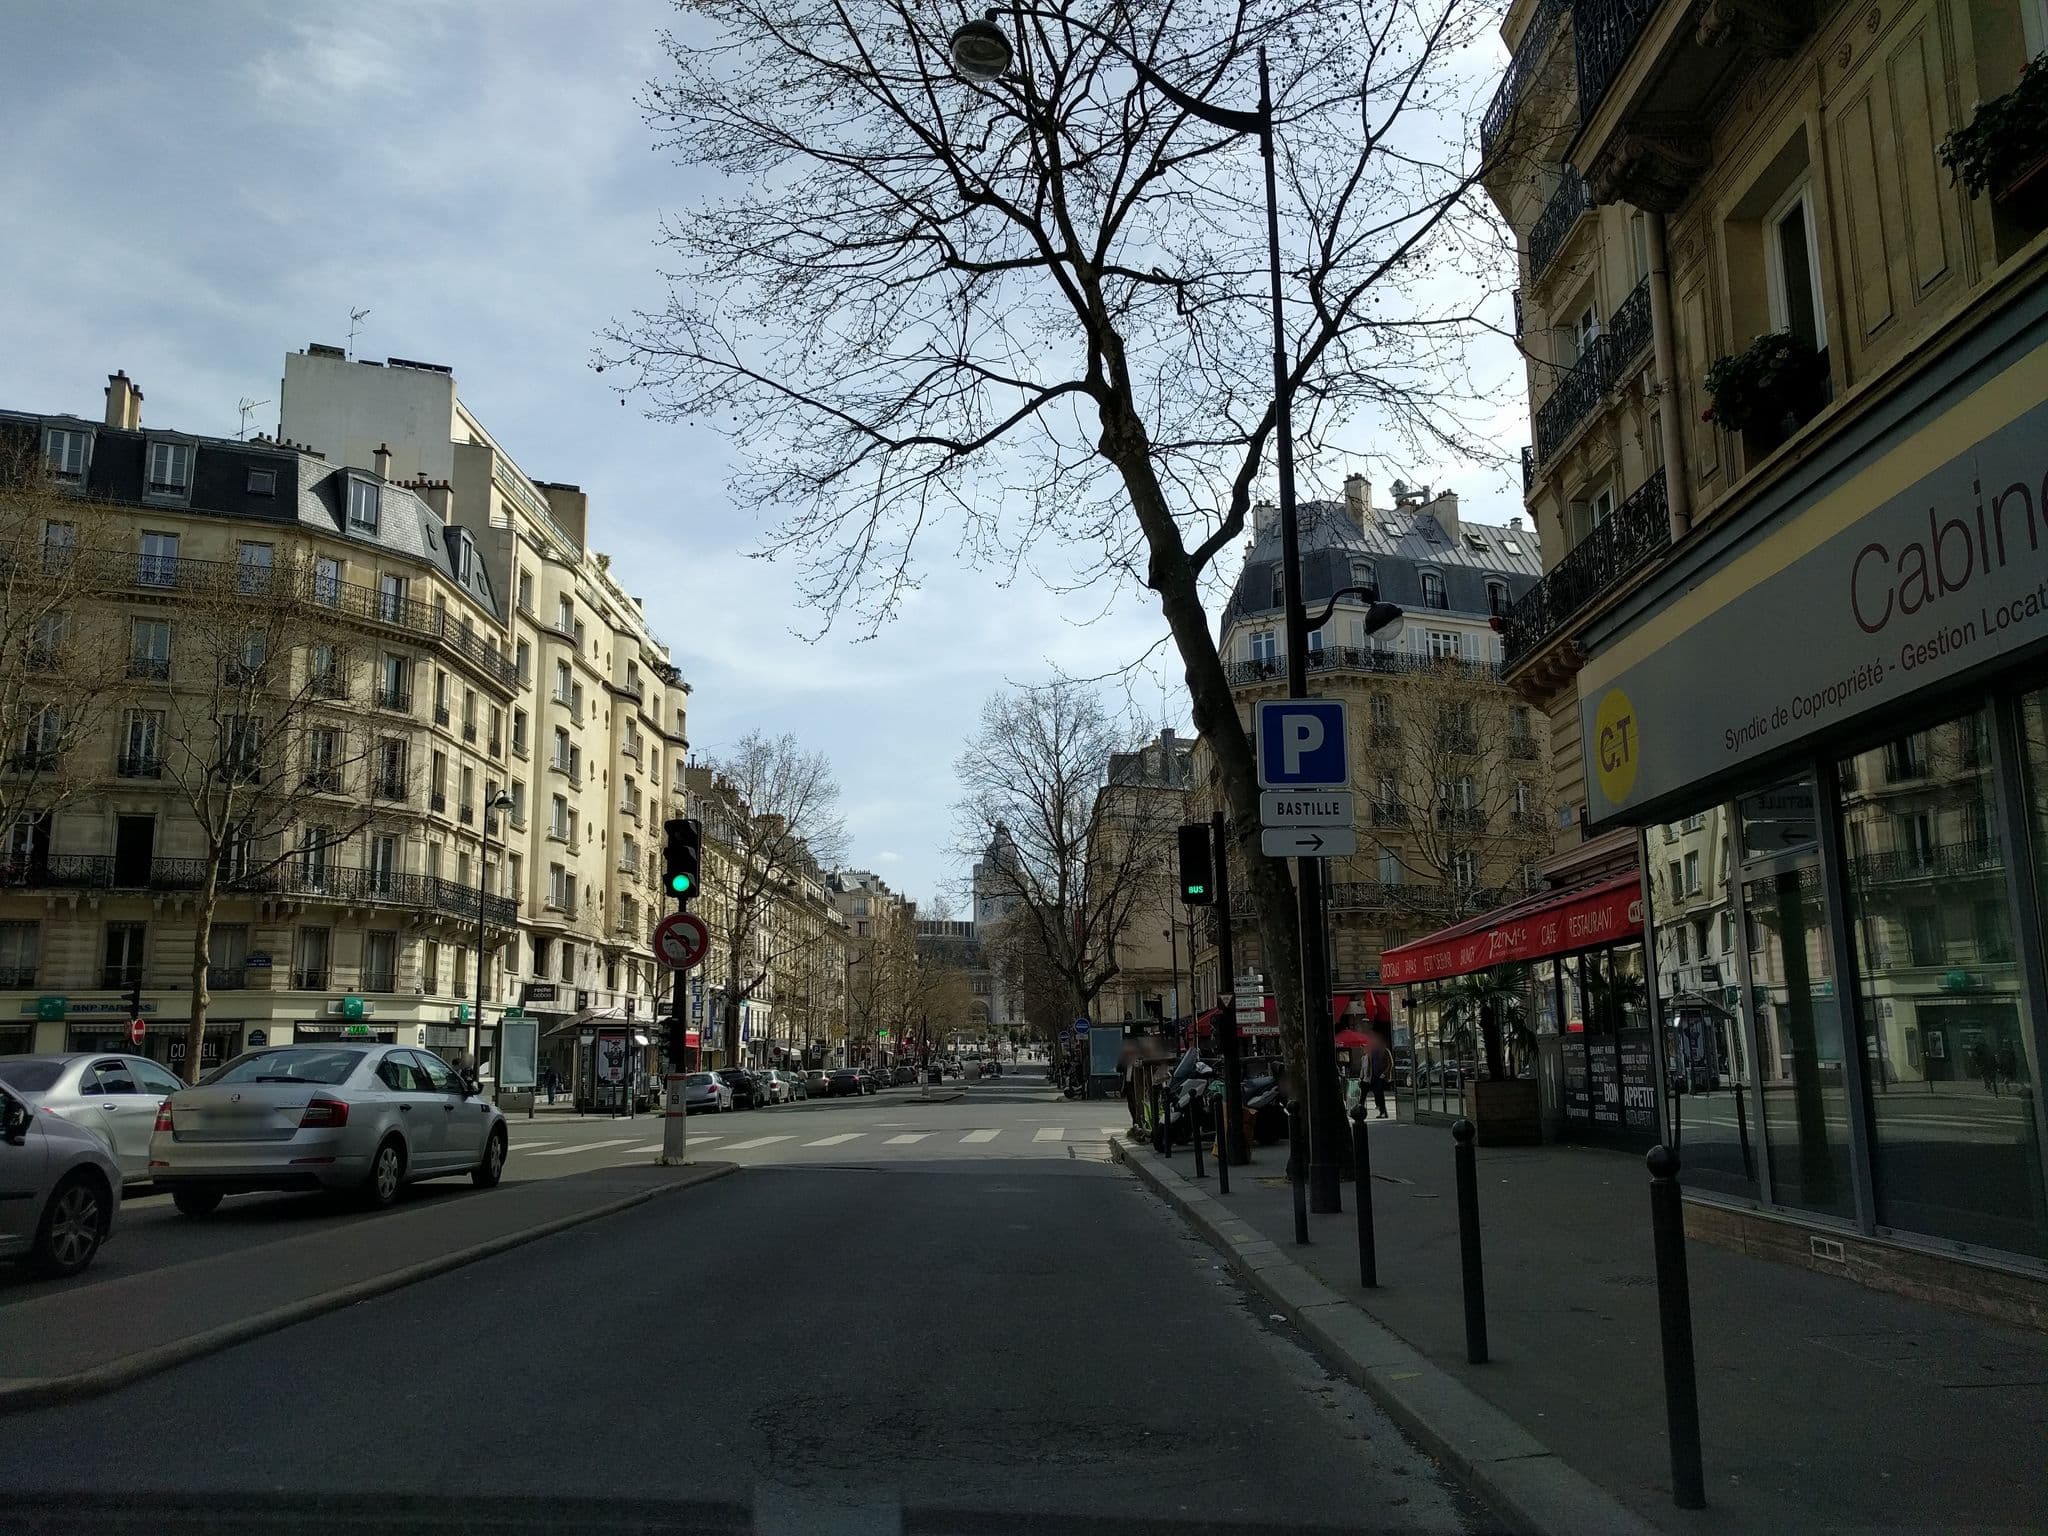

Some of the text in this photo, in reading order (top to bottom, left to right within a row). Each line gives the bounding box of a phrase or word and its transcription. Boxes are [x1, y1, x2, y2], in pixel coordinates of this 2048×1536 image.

[1851, 470, 2048, 634] Cabin
[1724, 716, 1768, 752] Syndic
[1771, 706, 1788, 730] de
[1791, 657, 1884, 720] Copropriété
[1901, 622, 1976, 671] Gestion
[1982, 579, 2048, 636] Locat
[1282, 714, 1325, 774] P
[1277, 802, 1340, 815] BASTILLE
[1188, 885, 1204, 895] BUS
[1568, 907, 1613, 938] RESTAURANT
[72, 1004, 98, 1012] BNP
[170, 1043, 217, 1058] COEIL
[1603, 1083, 1619, 1103] BON
[1623, 1086, 1655, 1108] APPETIT
